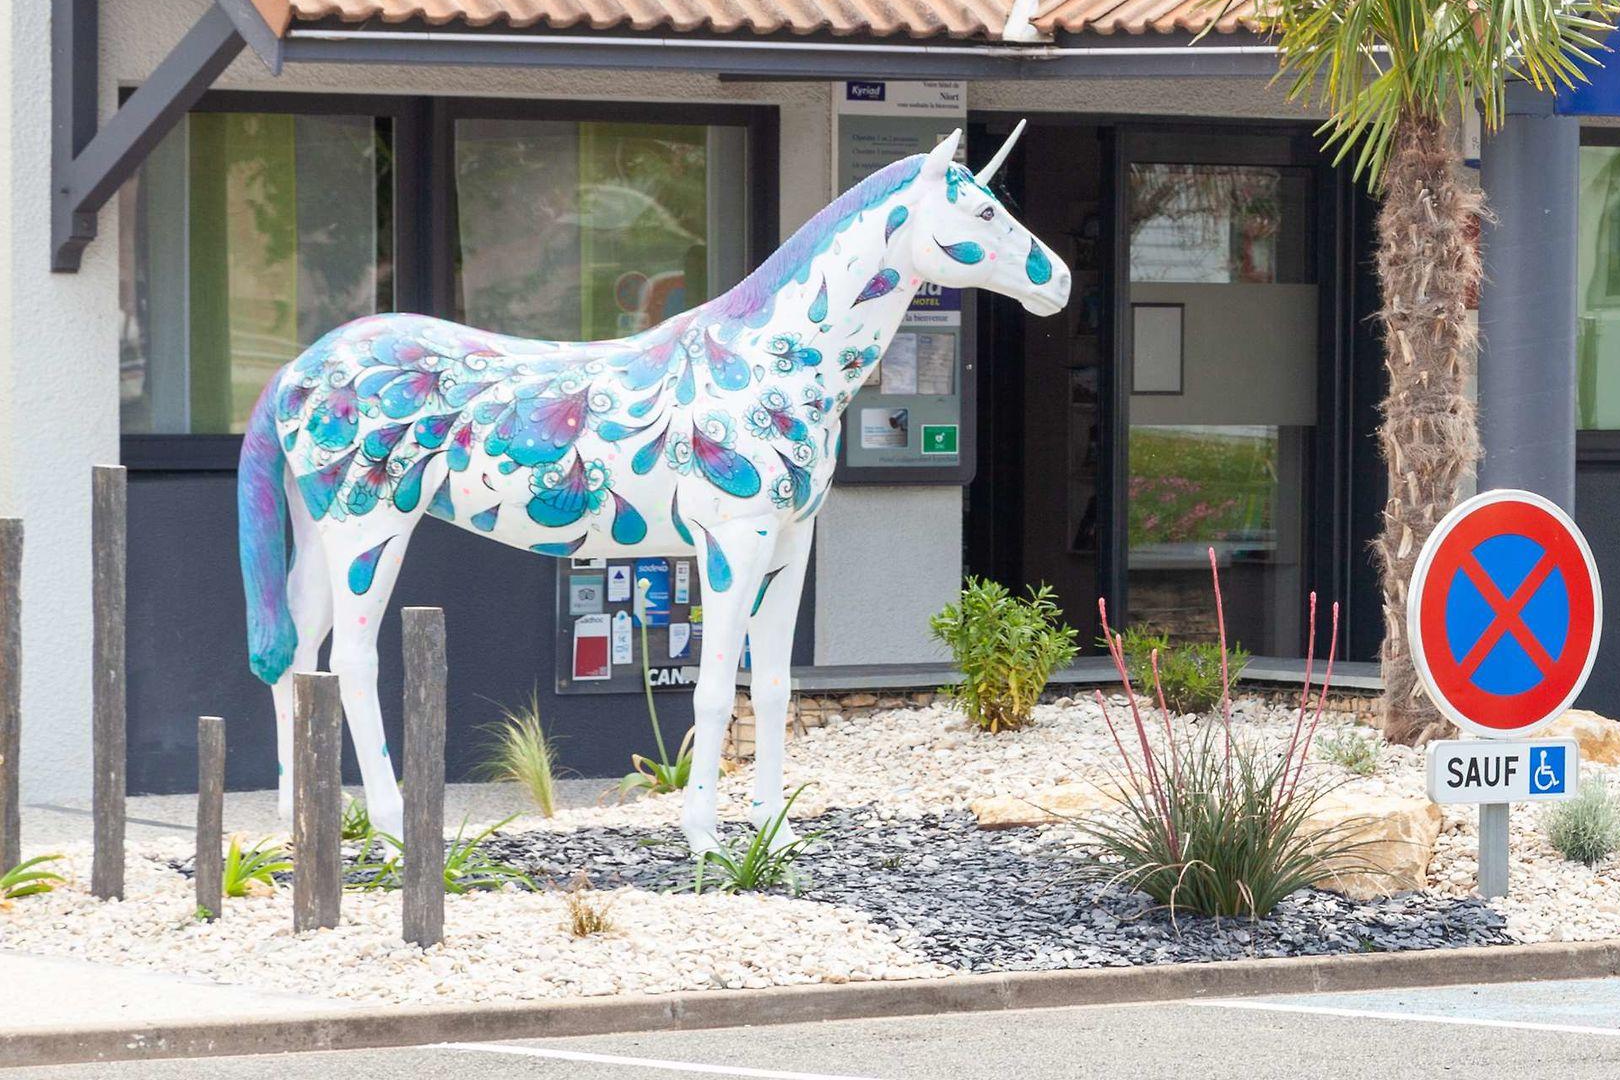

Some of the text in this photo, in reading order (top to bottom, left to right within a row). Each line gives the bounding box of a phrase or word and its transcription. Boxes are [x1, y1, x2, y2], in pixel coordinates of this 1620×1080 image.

[851, 85, 881, 96] Kyriad
[940, 92, 959, 101] Niort
[913, 298, 940, 306] HOTEL
[913, 313, 948, 322] bienvenue
[638, 564, 669, 573] sodexo
[1447, 756, 1519, 789] SAUF
